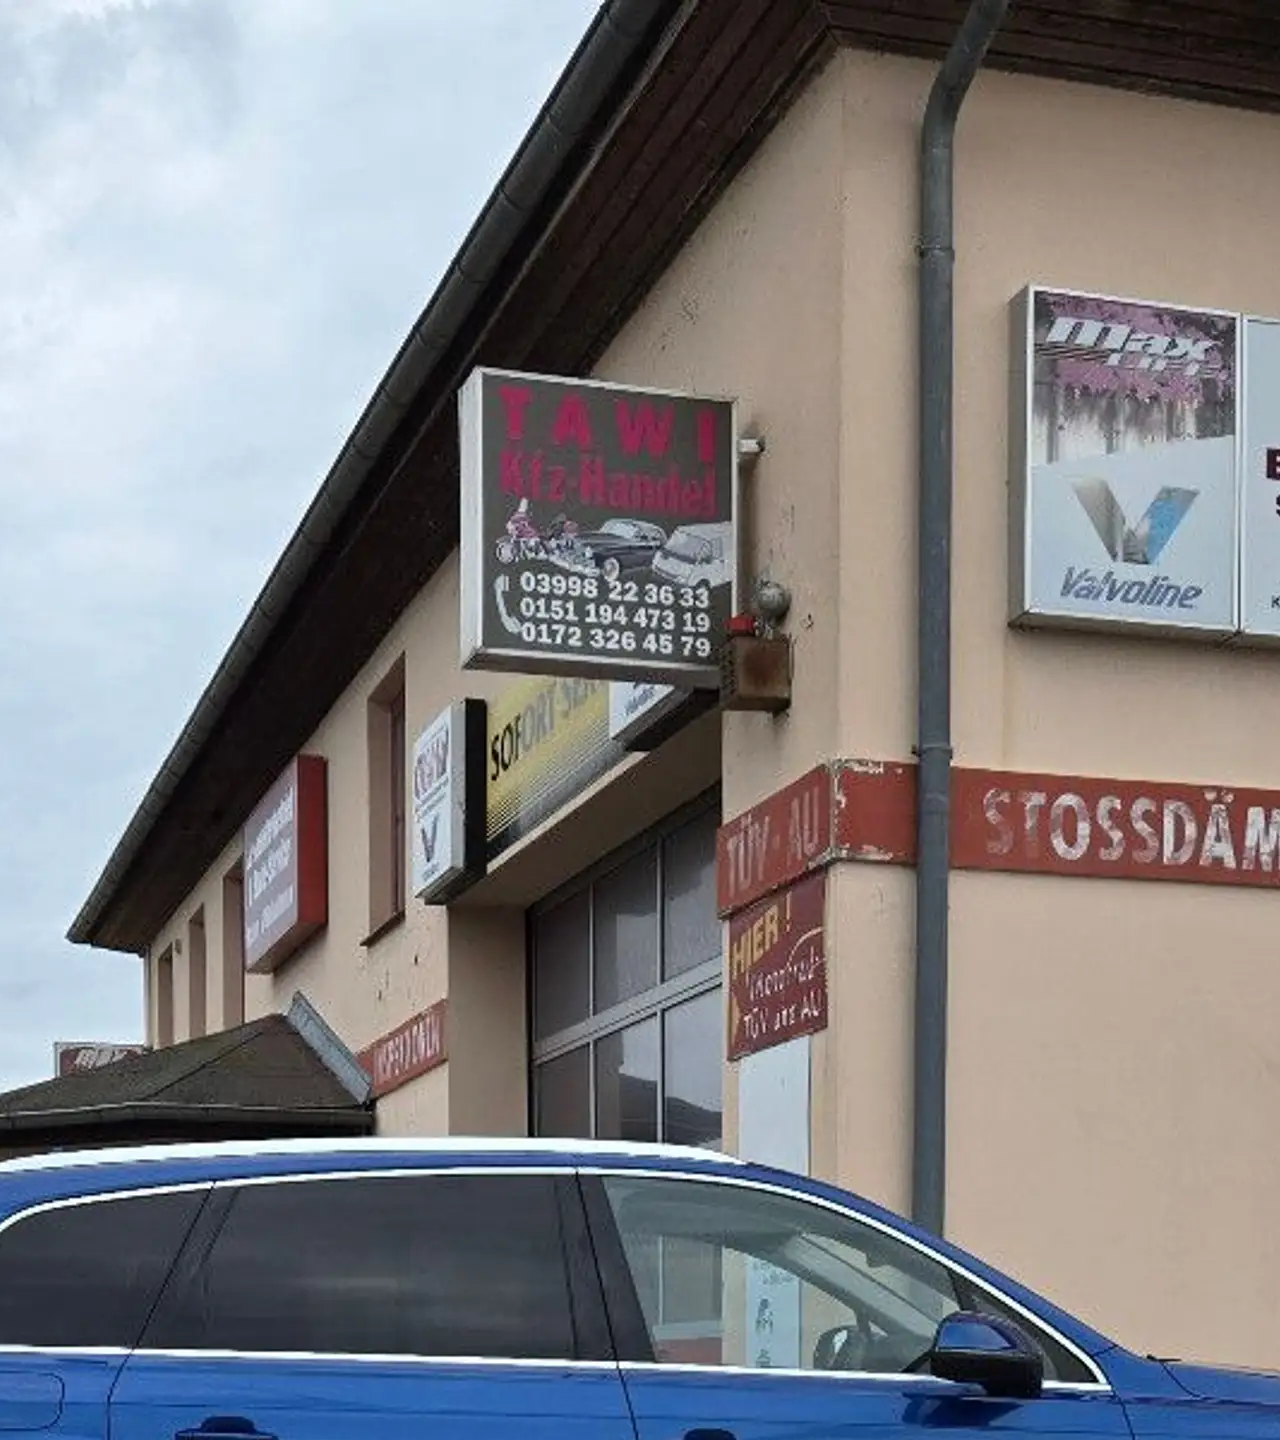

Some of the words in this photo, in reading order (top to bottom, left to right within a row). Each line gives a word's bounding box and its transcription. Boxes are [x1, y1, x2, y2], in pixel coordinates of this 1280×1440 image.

[497, 448, 716, 517] Kfz-Handel
[520, 571, 599, 597] 03998
[608, 580, 637, 602] 22
[644, 583, 674, 604] 36
[681, 587, 709, 608] 33
[1060, 566, 1203, 610] Valvoline
[520, 597, 578, 622] 0151
[585, 602, 628, 626] 194
[632, 606, 676, 630] 473
[682, 610, 711, 633] 19
[521, 622, 583, 646] 0172
[589, 627, 637, 650] 326
[681, 635, 711, 658] 79
